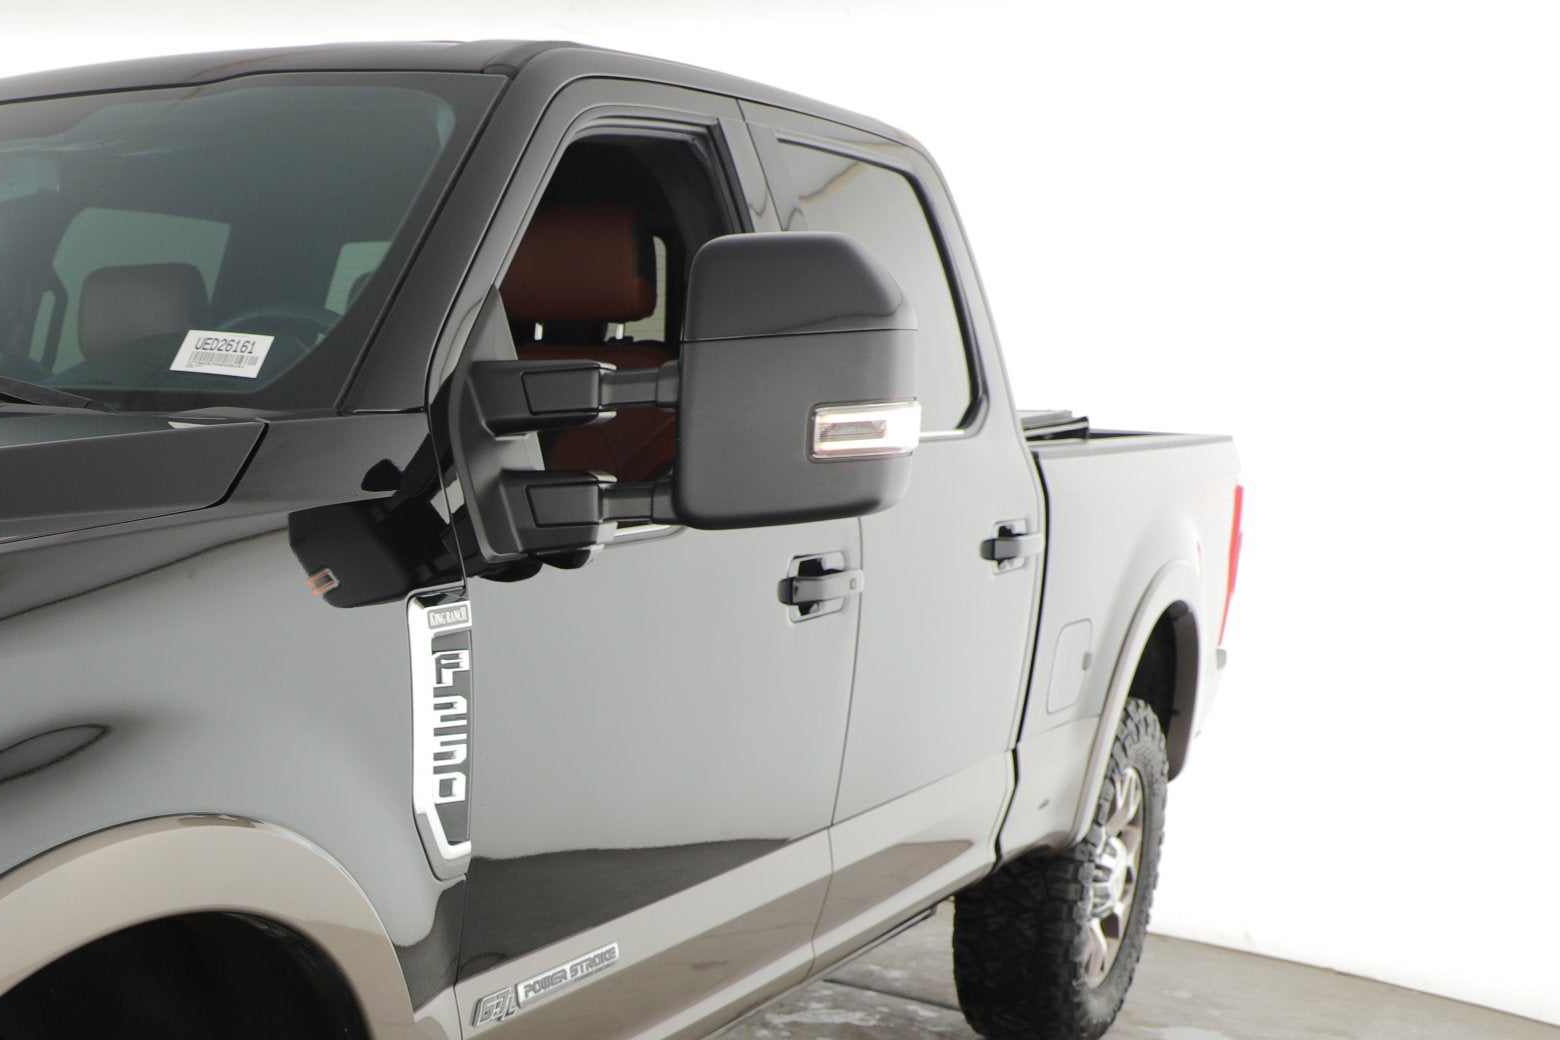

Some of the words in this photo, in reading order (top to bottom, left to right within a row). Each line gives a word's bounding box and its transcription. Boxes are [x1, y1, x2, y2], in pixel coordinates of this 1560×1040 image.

[195, 337, 256, 354] UED26161
[429, 611, 446, 627] KING
[446, 606, 468, 623] RANCH
[523, 968, 568, 1000] POWER
[569, 946, 617, 979] STROKE
